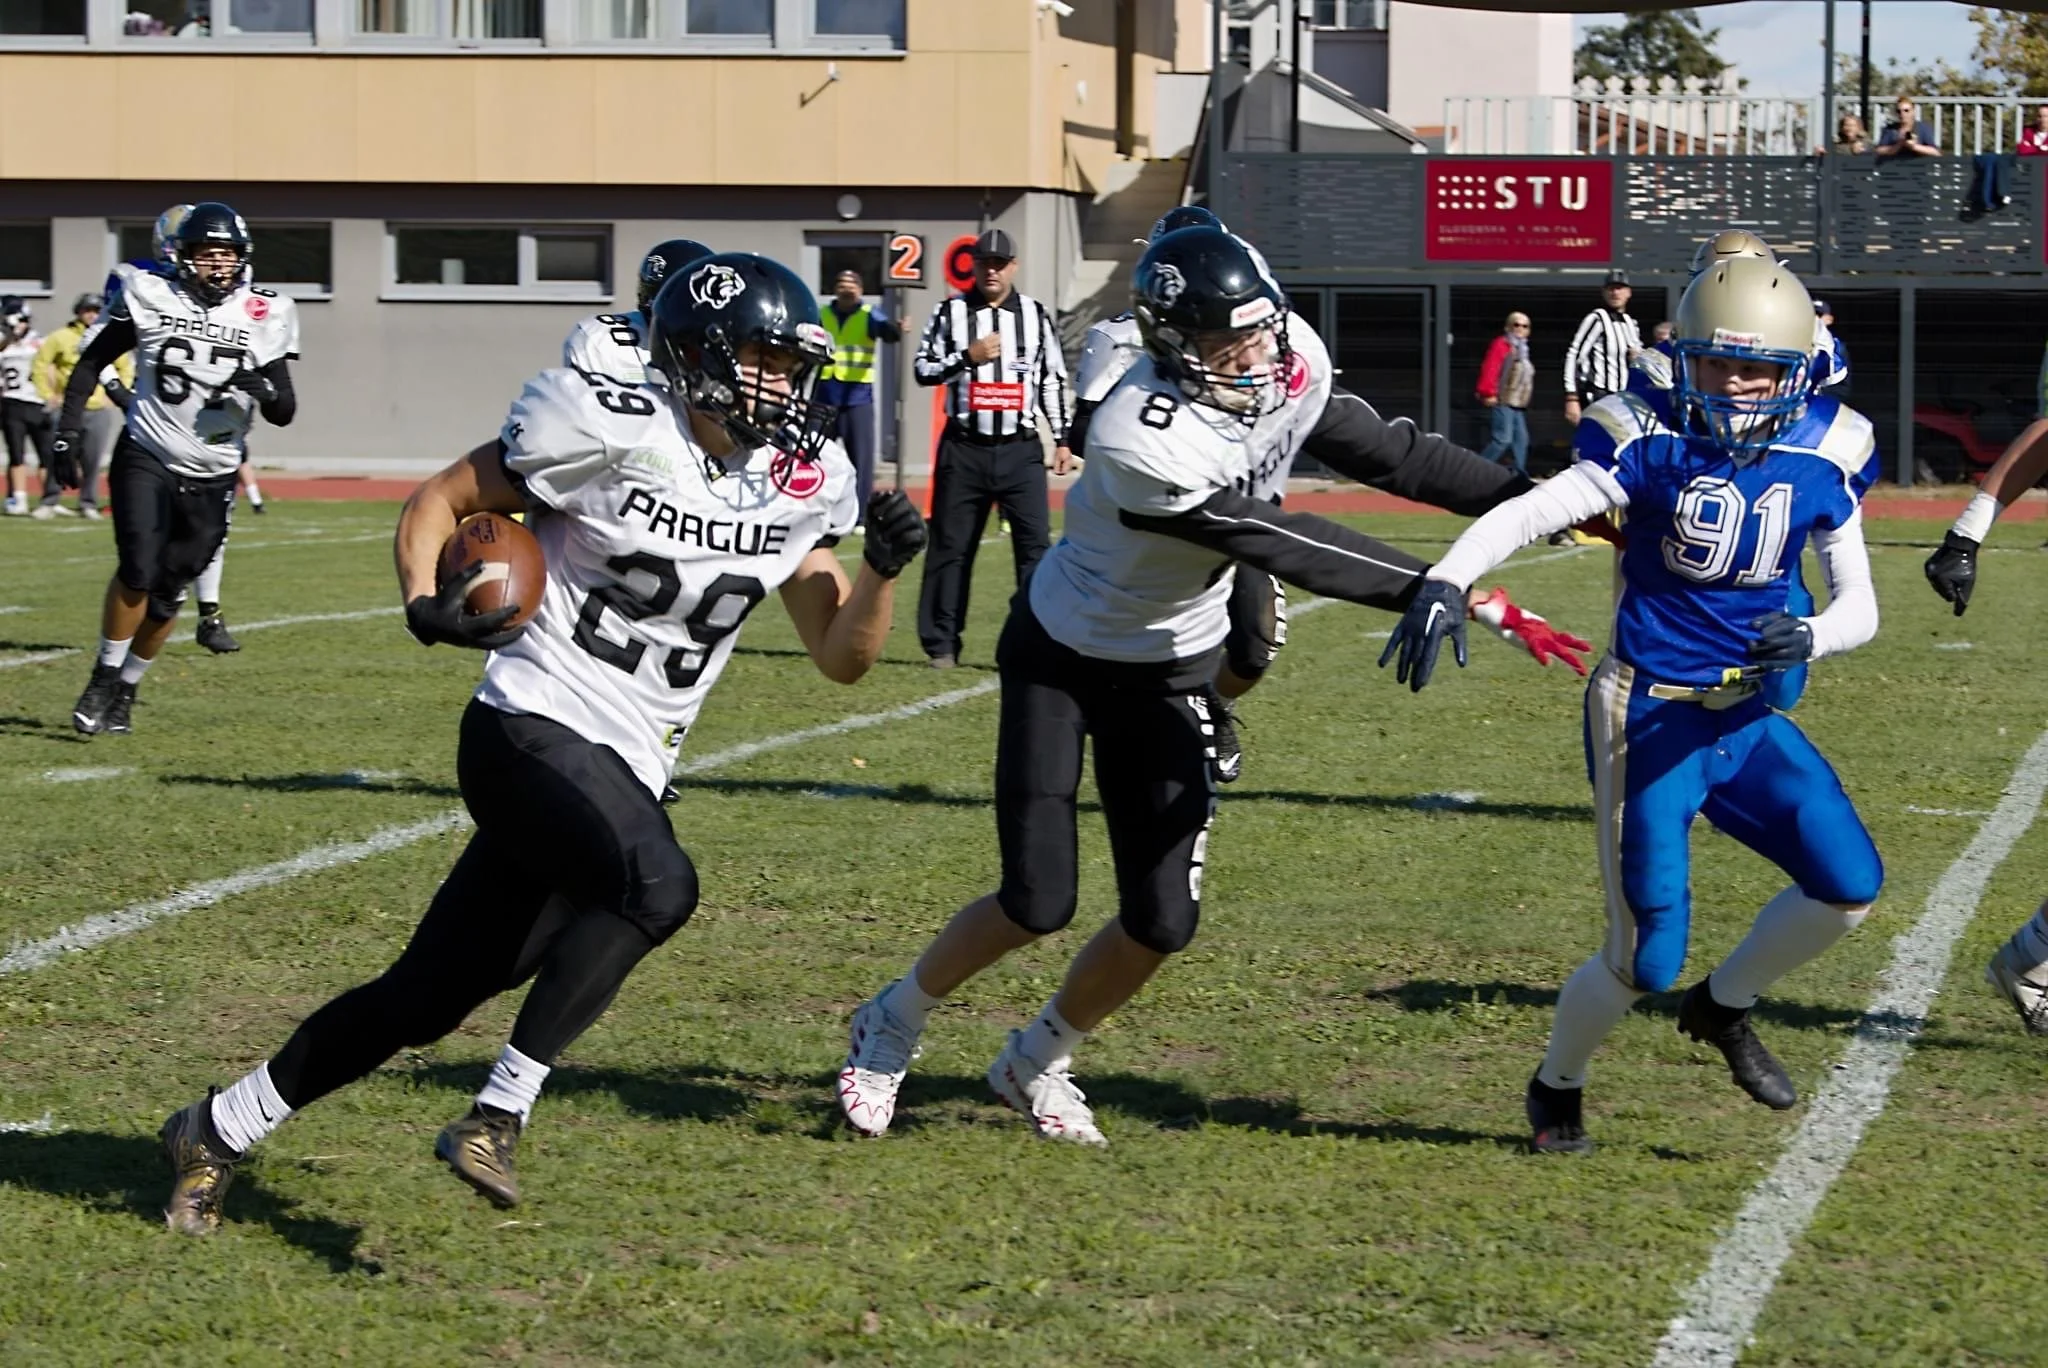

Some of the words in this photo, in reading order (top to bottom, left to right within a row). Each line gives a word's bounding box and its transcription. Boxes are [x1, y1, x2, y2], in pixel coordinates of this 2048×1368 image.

[1494, 175, 1588, 210] STU
[888, 234, 924, 281] 2
[158, 313, 249, 347] PRAGUE
[596, 313, 641, 347] 80
[156, 336, 248, 411] 67
[1138, 392, 1180, 431] 8
[617, 487, 790, 557] PRAGUE
[1660, 475, 1794, 588] 91
[571, 549, 767, 690] 29
